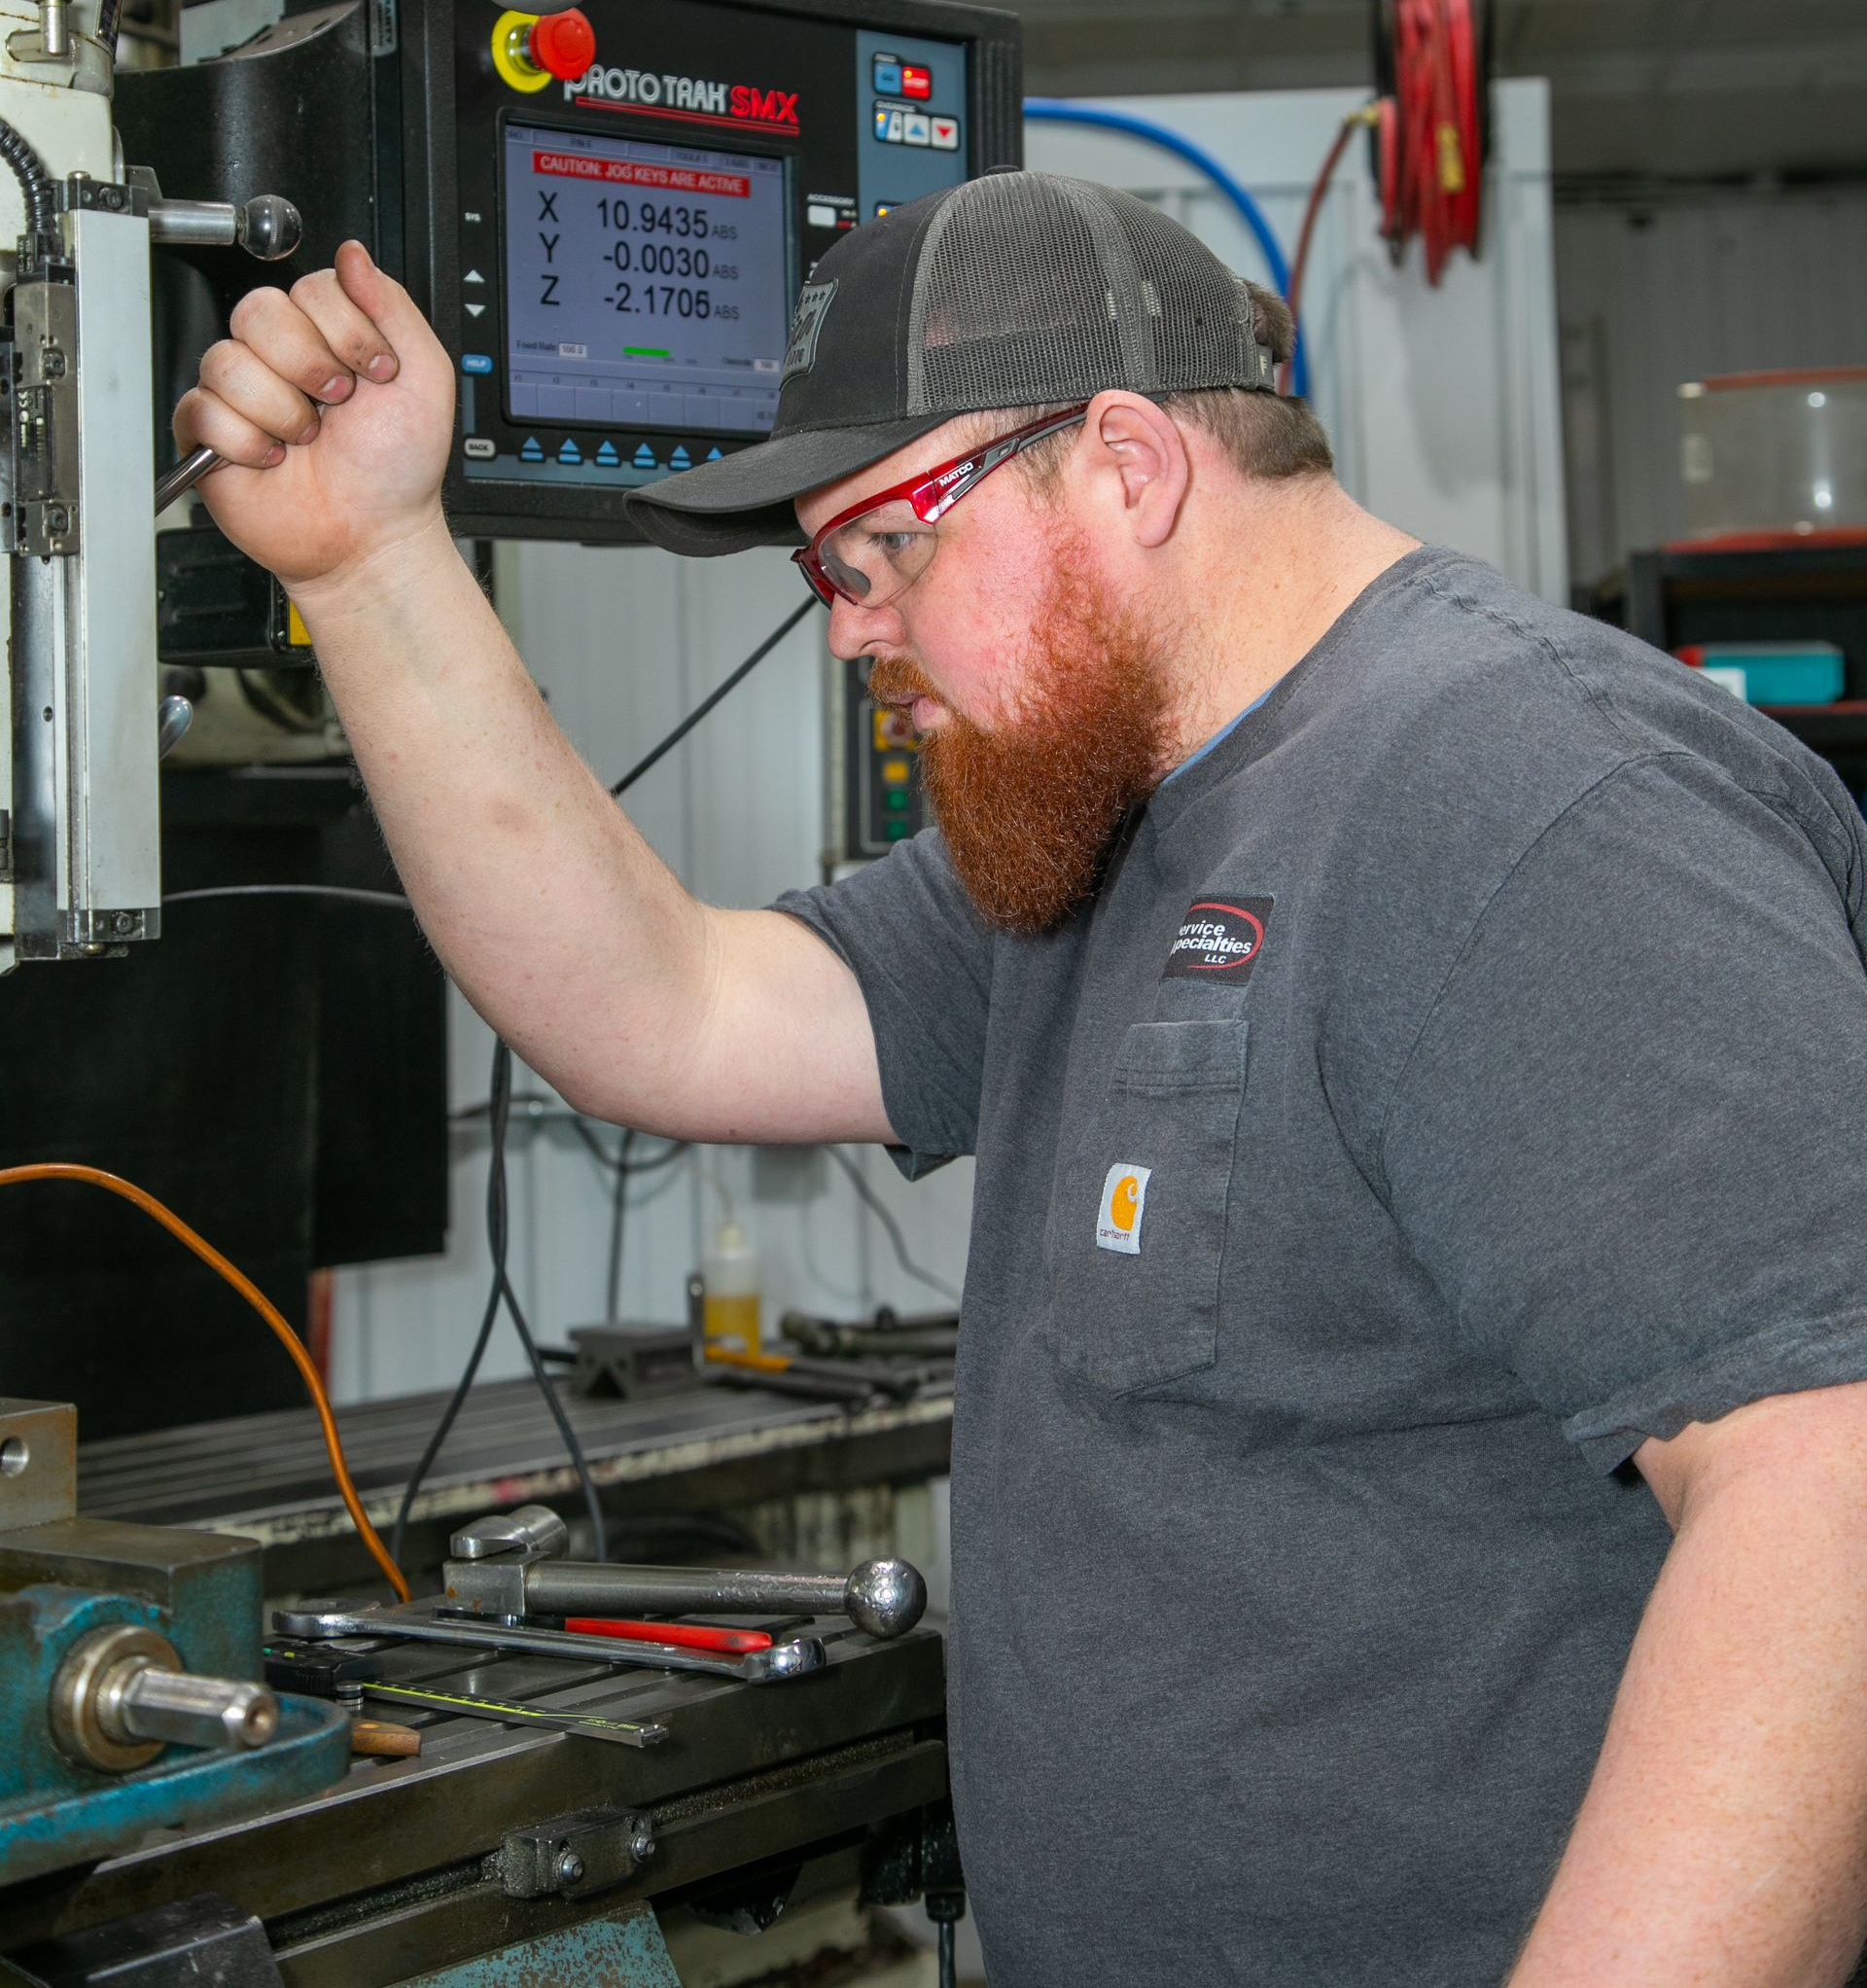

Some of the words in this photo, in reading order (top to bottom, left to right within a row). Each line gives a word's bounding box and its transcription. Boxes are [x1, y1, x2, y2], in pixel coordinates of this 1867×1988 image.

[563, 63, 661, 104] PROTO
[662, 74, 729, 115] TRAK
[730, 85, 799, 124] SMX
[540, 156, 603, 176] CAUTION:
[605, 163, 633, 182] JOG
[634, 166, 670, 185] KEYS
[669, 170, 697, 188] ARE
[698, 174, 744, 194] ACTIVE
[538, 190, 559, 223] X
[596, 197, 709, 239] 10.9435
[711, 225, 738, 240] ABS
[538, 231, 560, 264] Y
[603, 240, 710, 279] -0.0030
[712, 265, 739, 280] ABS
[540, 274, 561, 307] Z
[604, 281, 711, 321] -2.1705
[713, 304, 740, 321] ABS
[939, 462, 974, 487] MATCO
[1169, 935, 1252, 956] pecialties
[1179, 920, 1226, 937] ervice
[1204, 954, 1227, 964] LLC
